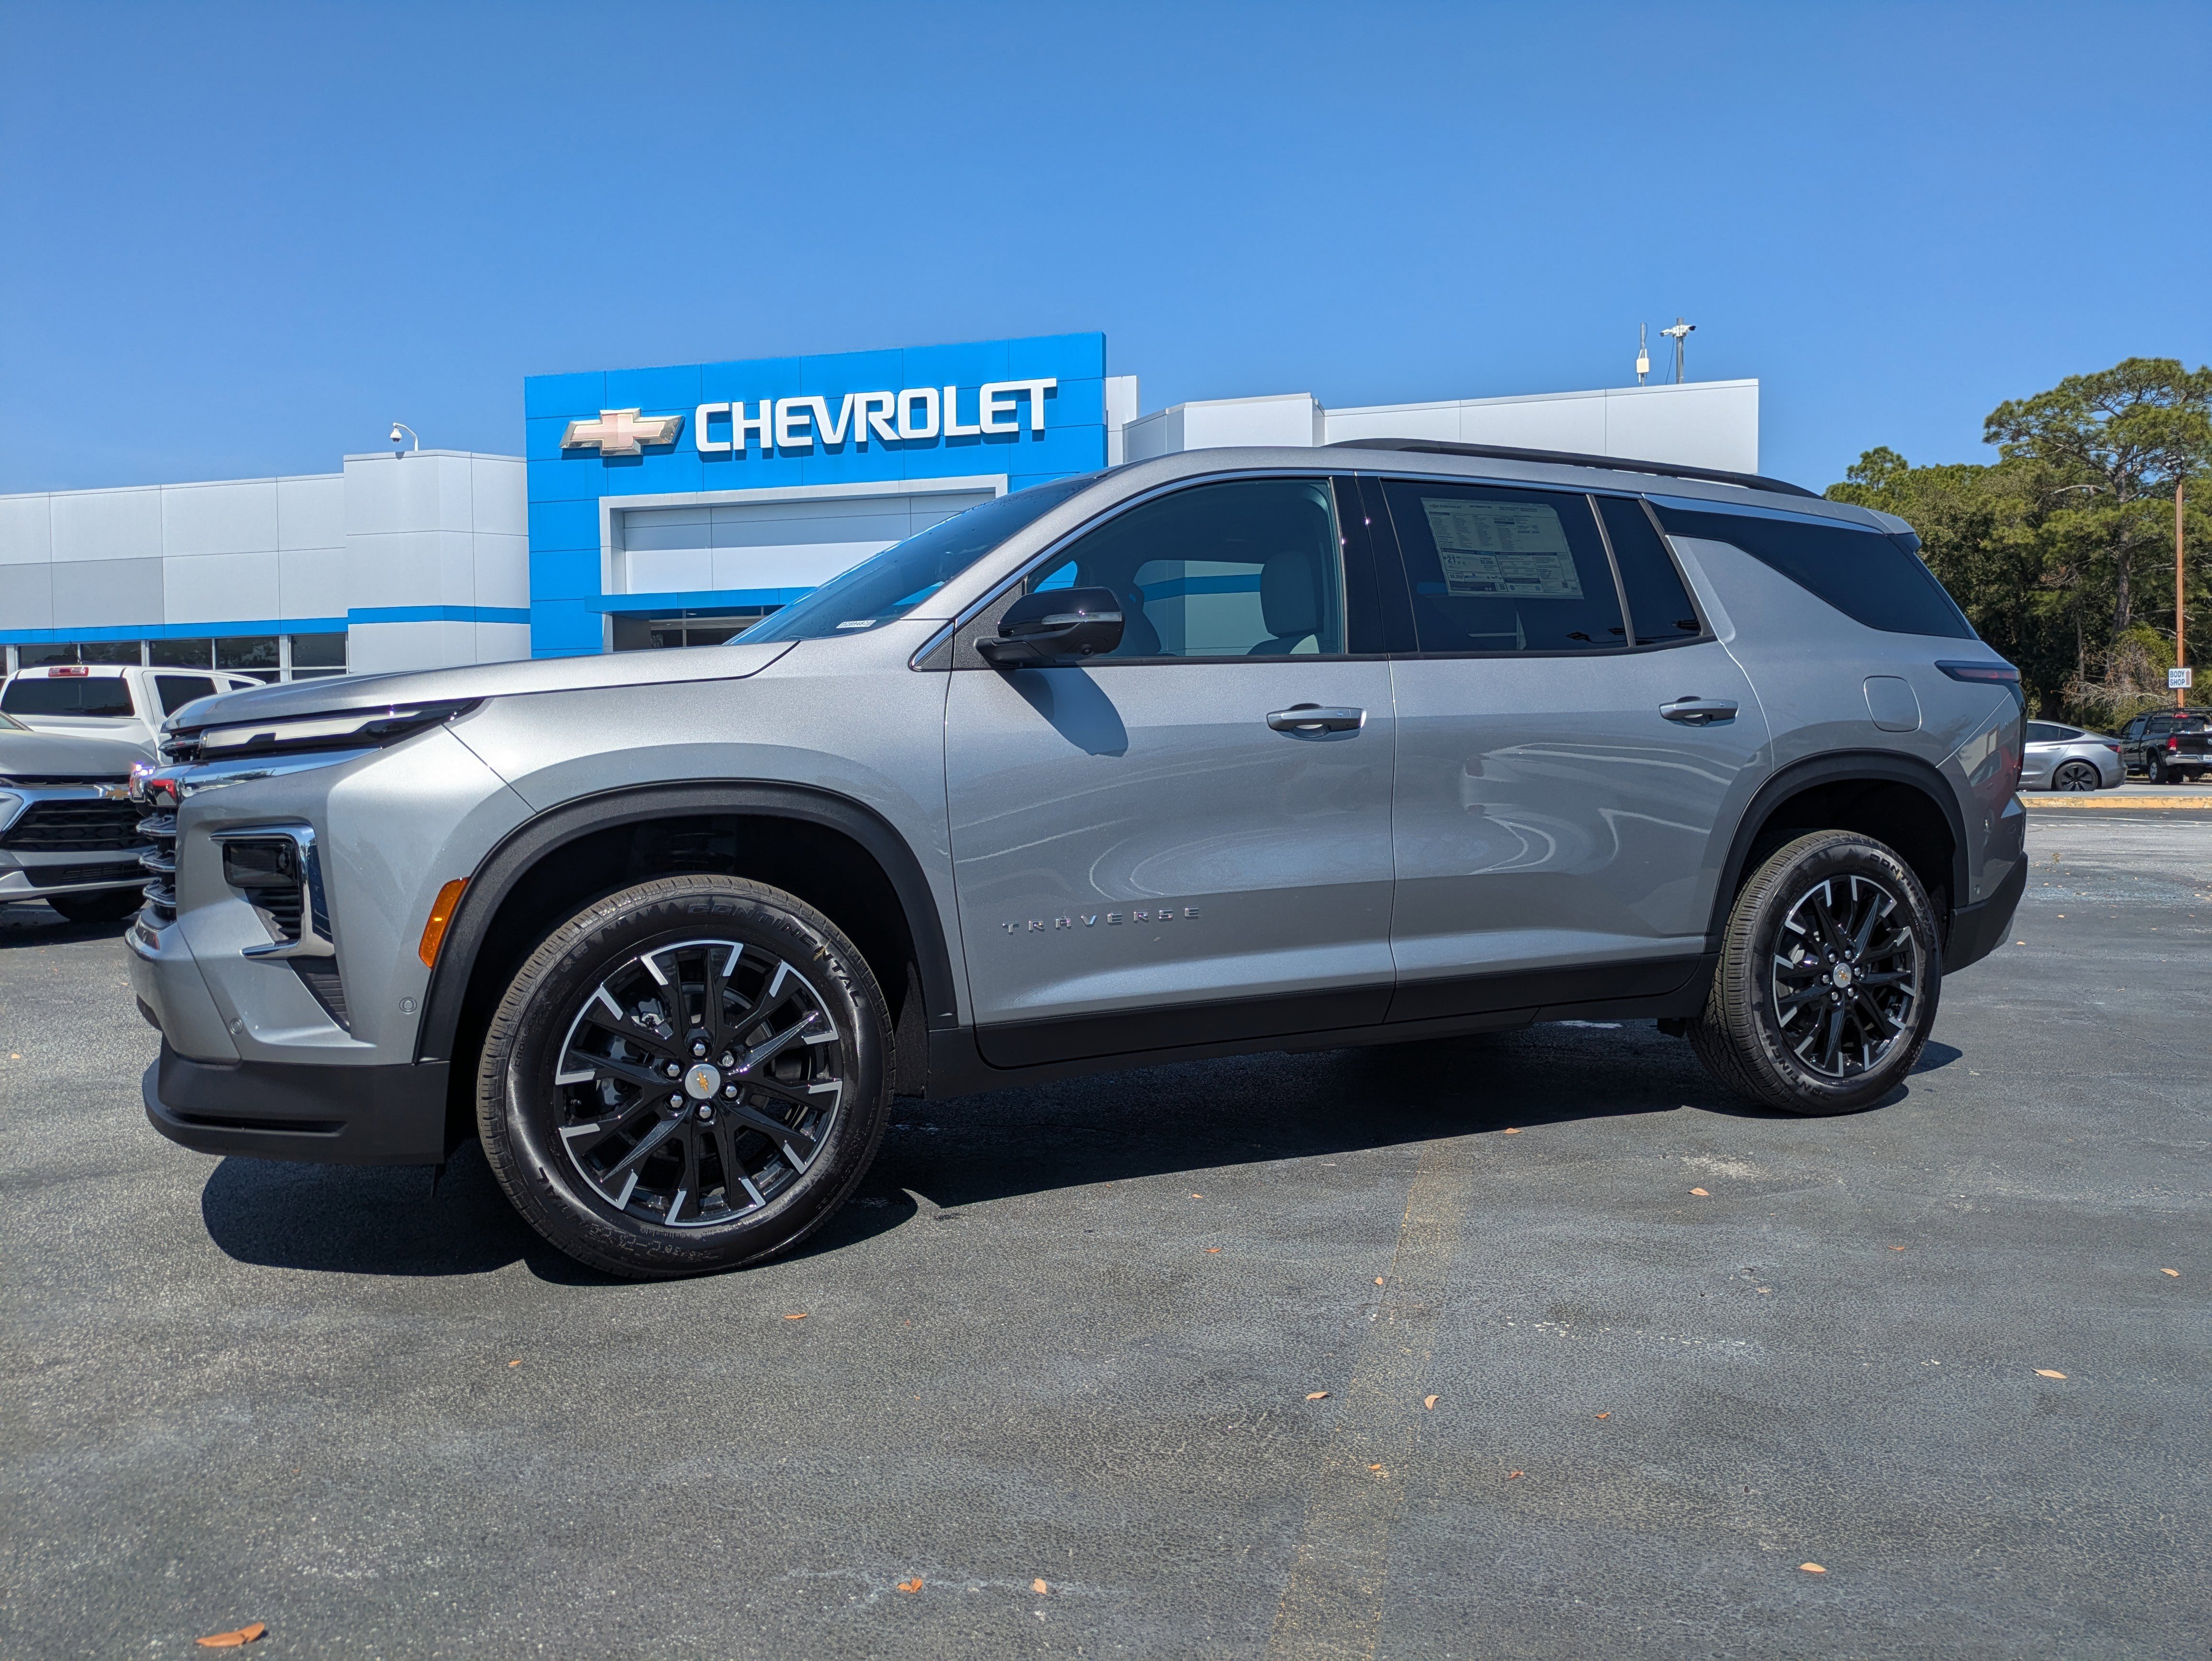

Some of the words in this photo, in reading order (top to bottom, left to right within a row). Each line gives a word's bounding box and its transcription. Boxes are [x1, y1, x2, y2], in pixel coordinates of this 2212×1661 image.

[695, 377, 1058, 453] CHEVROLET
[687, 903, 861, 1008] CONTINENTAL
[1002, 906, 1200, 934] TRAVERSE
